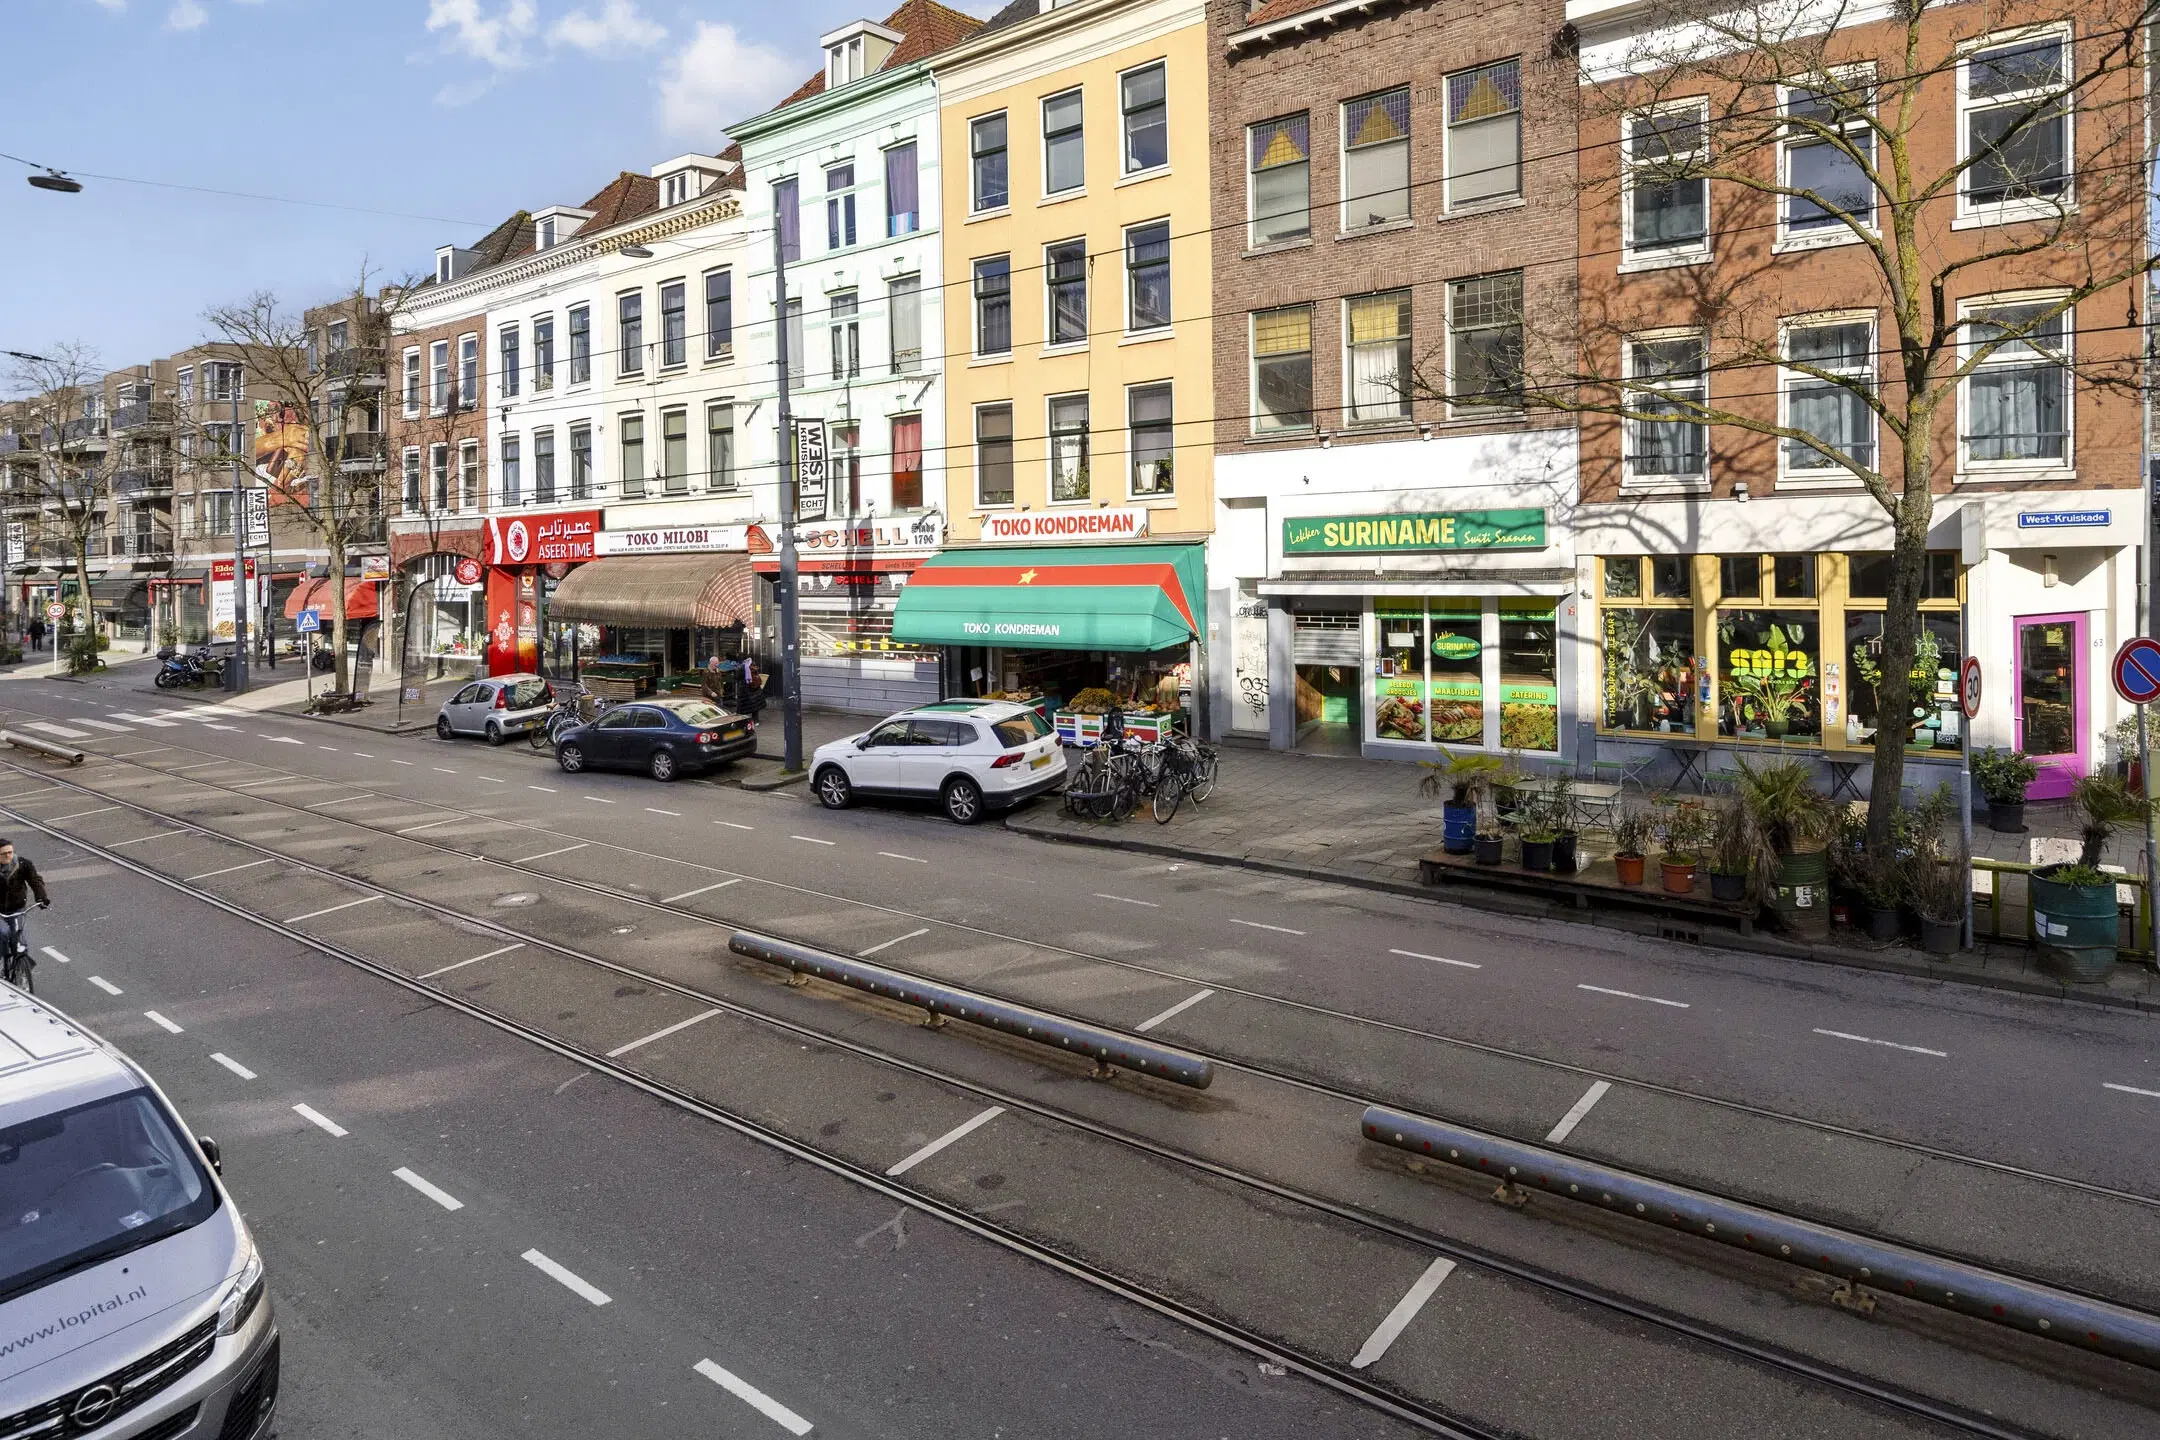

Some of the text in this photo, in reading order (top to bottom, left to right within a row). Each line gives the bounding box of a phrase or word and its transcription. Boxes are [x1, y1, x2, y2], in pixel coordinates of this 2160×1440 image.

[800, 427, 809, 491] KRUISKADE
[808, 427, 824, 490] WEST
[255, 492, 266, 529] WEST
[801, 499, 824, 508] ECHT
[992, 514, 1134, 536] TOKO KONDREMAN
[2026, 514, 2105, 524] West-Kruiskade
[626, 530, 709, 546] TOKO MILOBI
[807, 527, 908, 548] SCHELL
[914, 534, 935, 545] 1796
[1288, 525, 1321, 545] Lekker
[1324, 518, 1456, 547] SURINAME
[1495, 529, 1536, 544] Sranan
[538, 543, 567, 559] ASEER
[568, 542, 592, 557] TIME
[834, 575, 882, 586] SCHELL
[963, 622, 1060, 636] TOKO KONDREMAN
[1436, 642, 1476, 651] SURINAME
[2093, 639, 2104, 647] 63
[1434, 687, 1481, 697] MAALTIJDEN
[1510, 691, 1548, 700] CATERING
[1967, 675, 1979, 700] 30
[0, 1286, 147, 1357] www.lopital.nl
